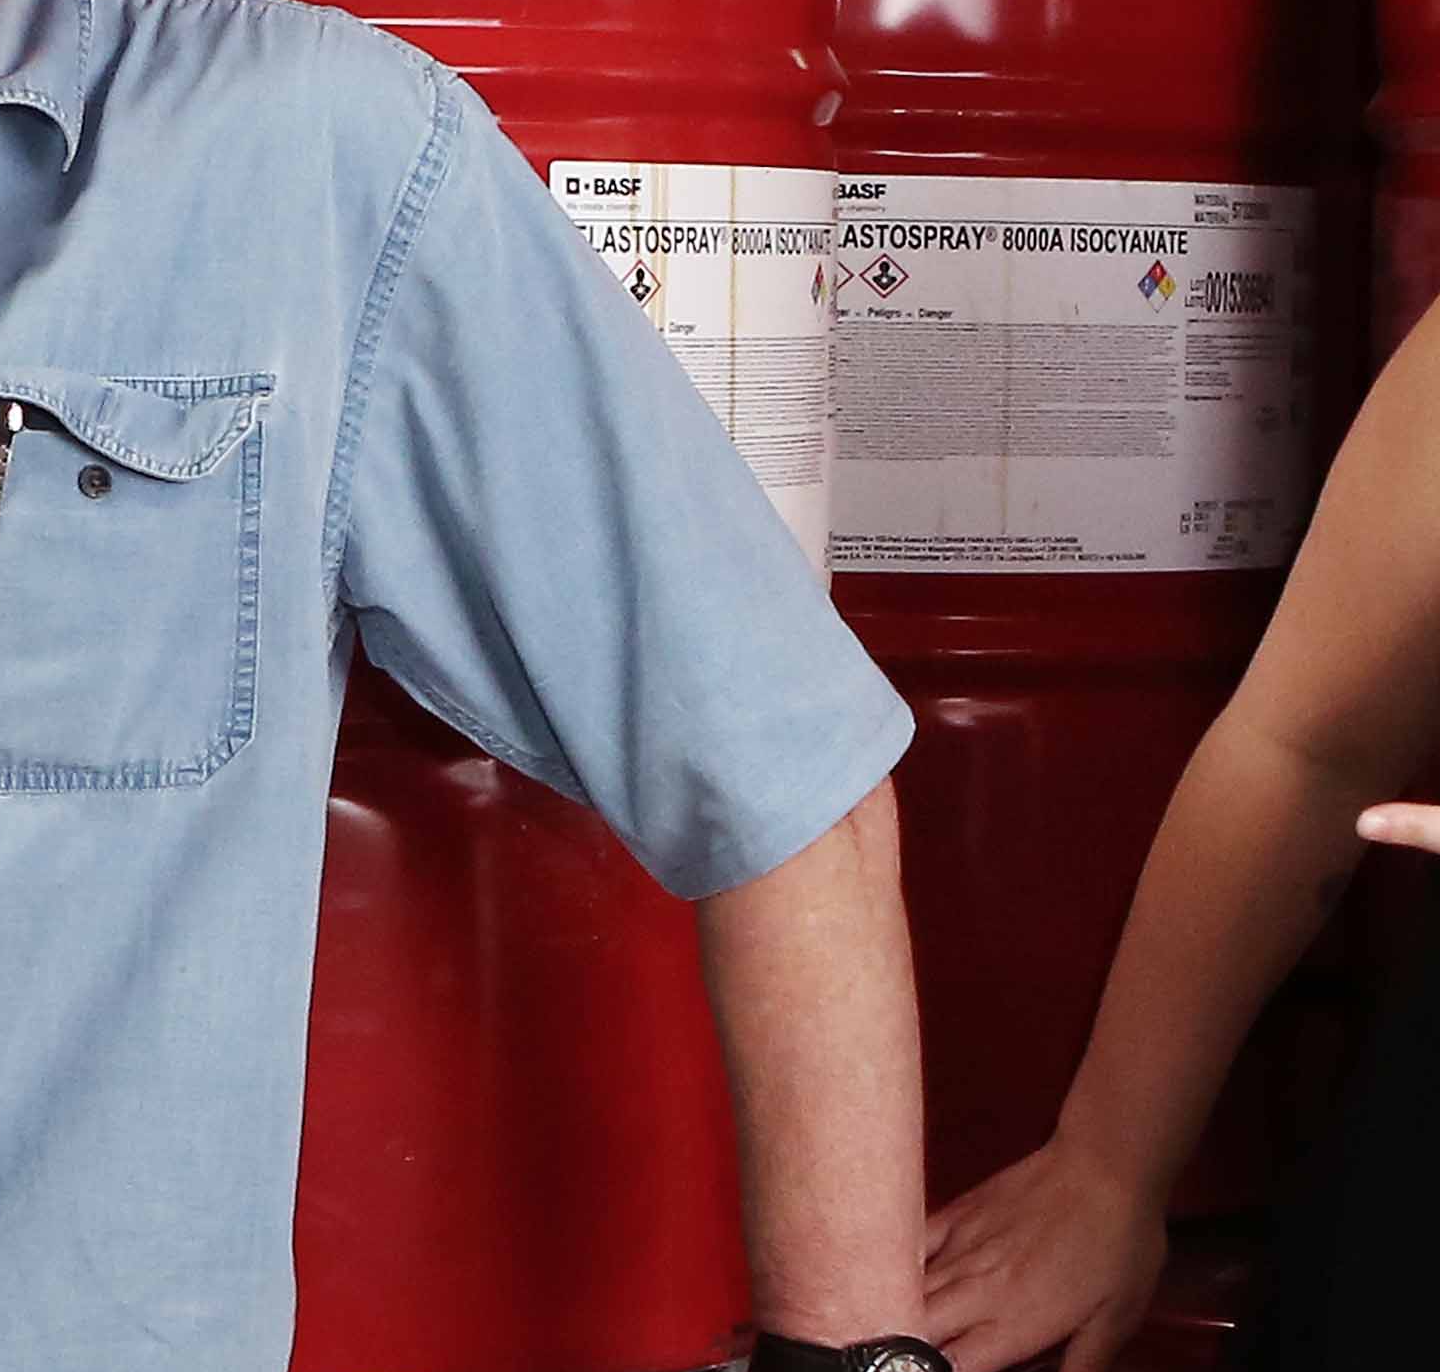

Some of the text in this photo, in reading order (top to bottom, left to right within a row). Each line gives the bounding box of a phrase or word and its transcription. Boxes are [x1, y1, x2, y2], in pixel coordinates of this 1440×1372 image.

[594, 178, 641, 195] BASF
[838, 183, 887, 199] BASF
[732, 229, 771, 255] 8000A
[838, 224, 1188, 254] ASTOSPRAY® 8000A ISOCYANATE
[867, 307, 953, 320] Peligro Danger
[669, 322, 695, 335] Danger
